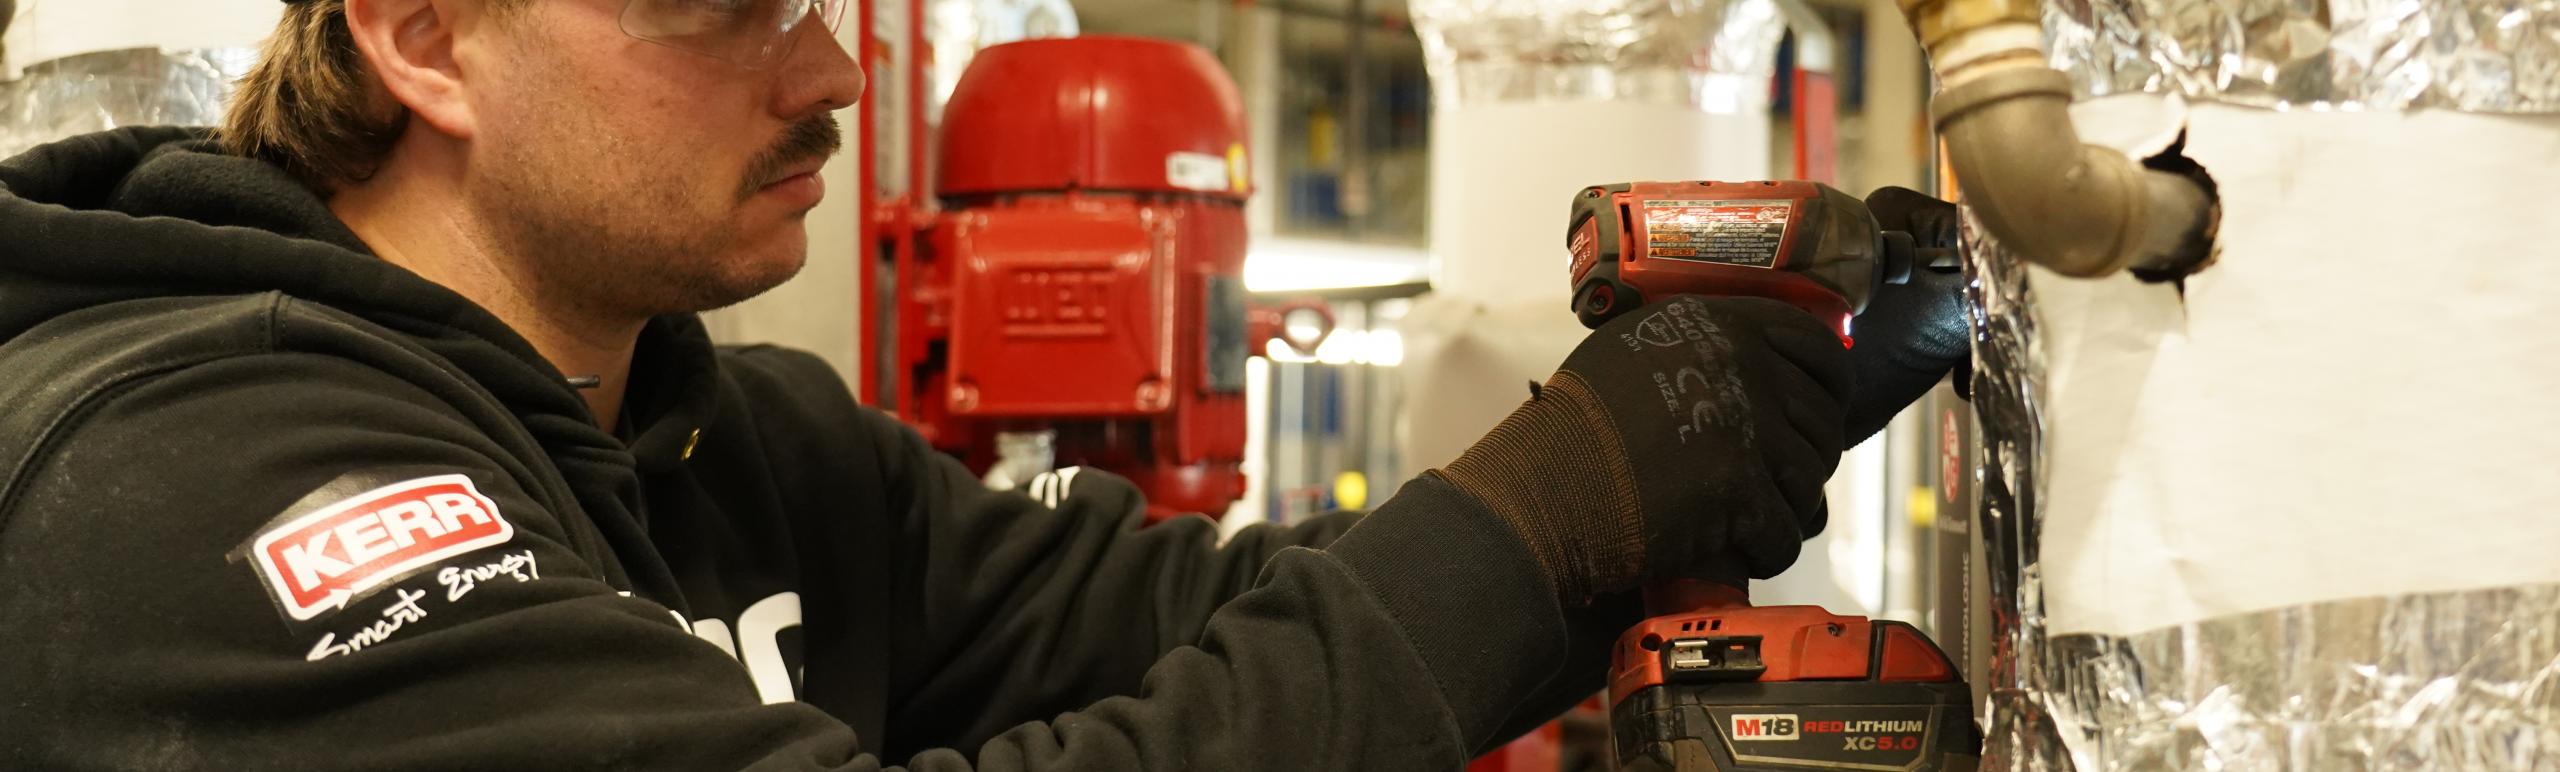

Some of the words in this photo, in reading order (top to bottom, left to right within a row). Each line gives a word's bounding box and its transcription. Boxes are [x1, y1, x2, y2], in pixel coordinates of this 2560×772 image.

[1676, 366, 1725, 434] CE
[1678, 424, 1692, 445] L
[281, 493, 494, 592] KERR
[306, 588, 427, 662] Smart
[437, 549, 540, 604] Energy
[1962, 551, 1970, 684] ECHNOLOGIC
[1736, 717, 1795, 736] M18
[1803, 720, 1923, 733] REDLITHIUM
[1843, 735, 1918, 751] XC5.0
